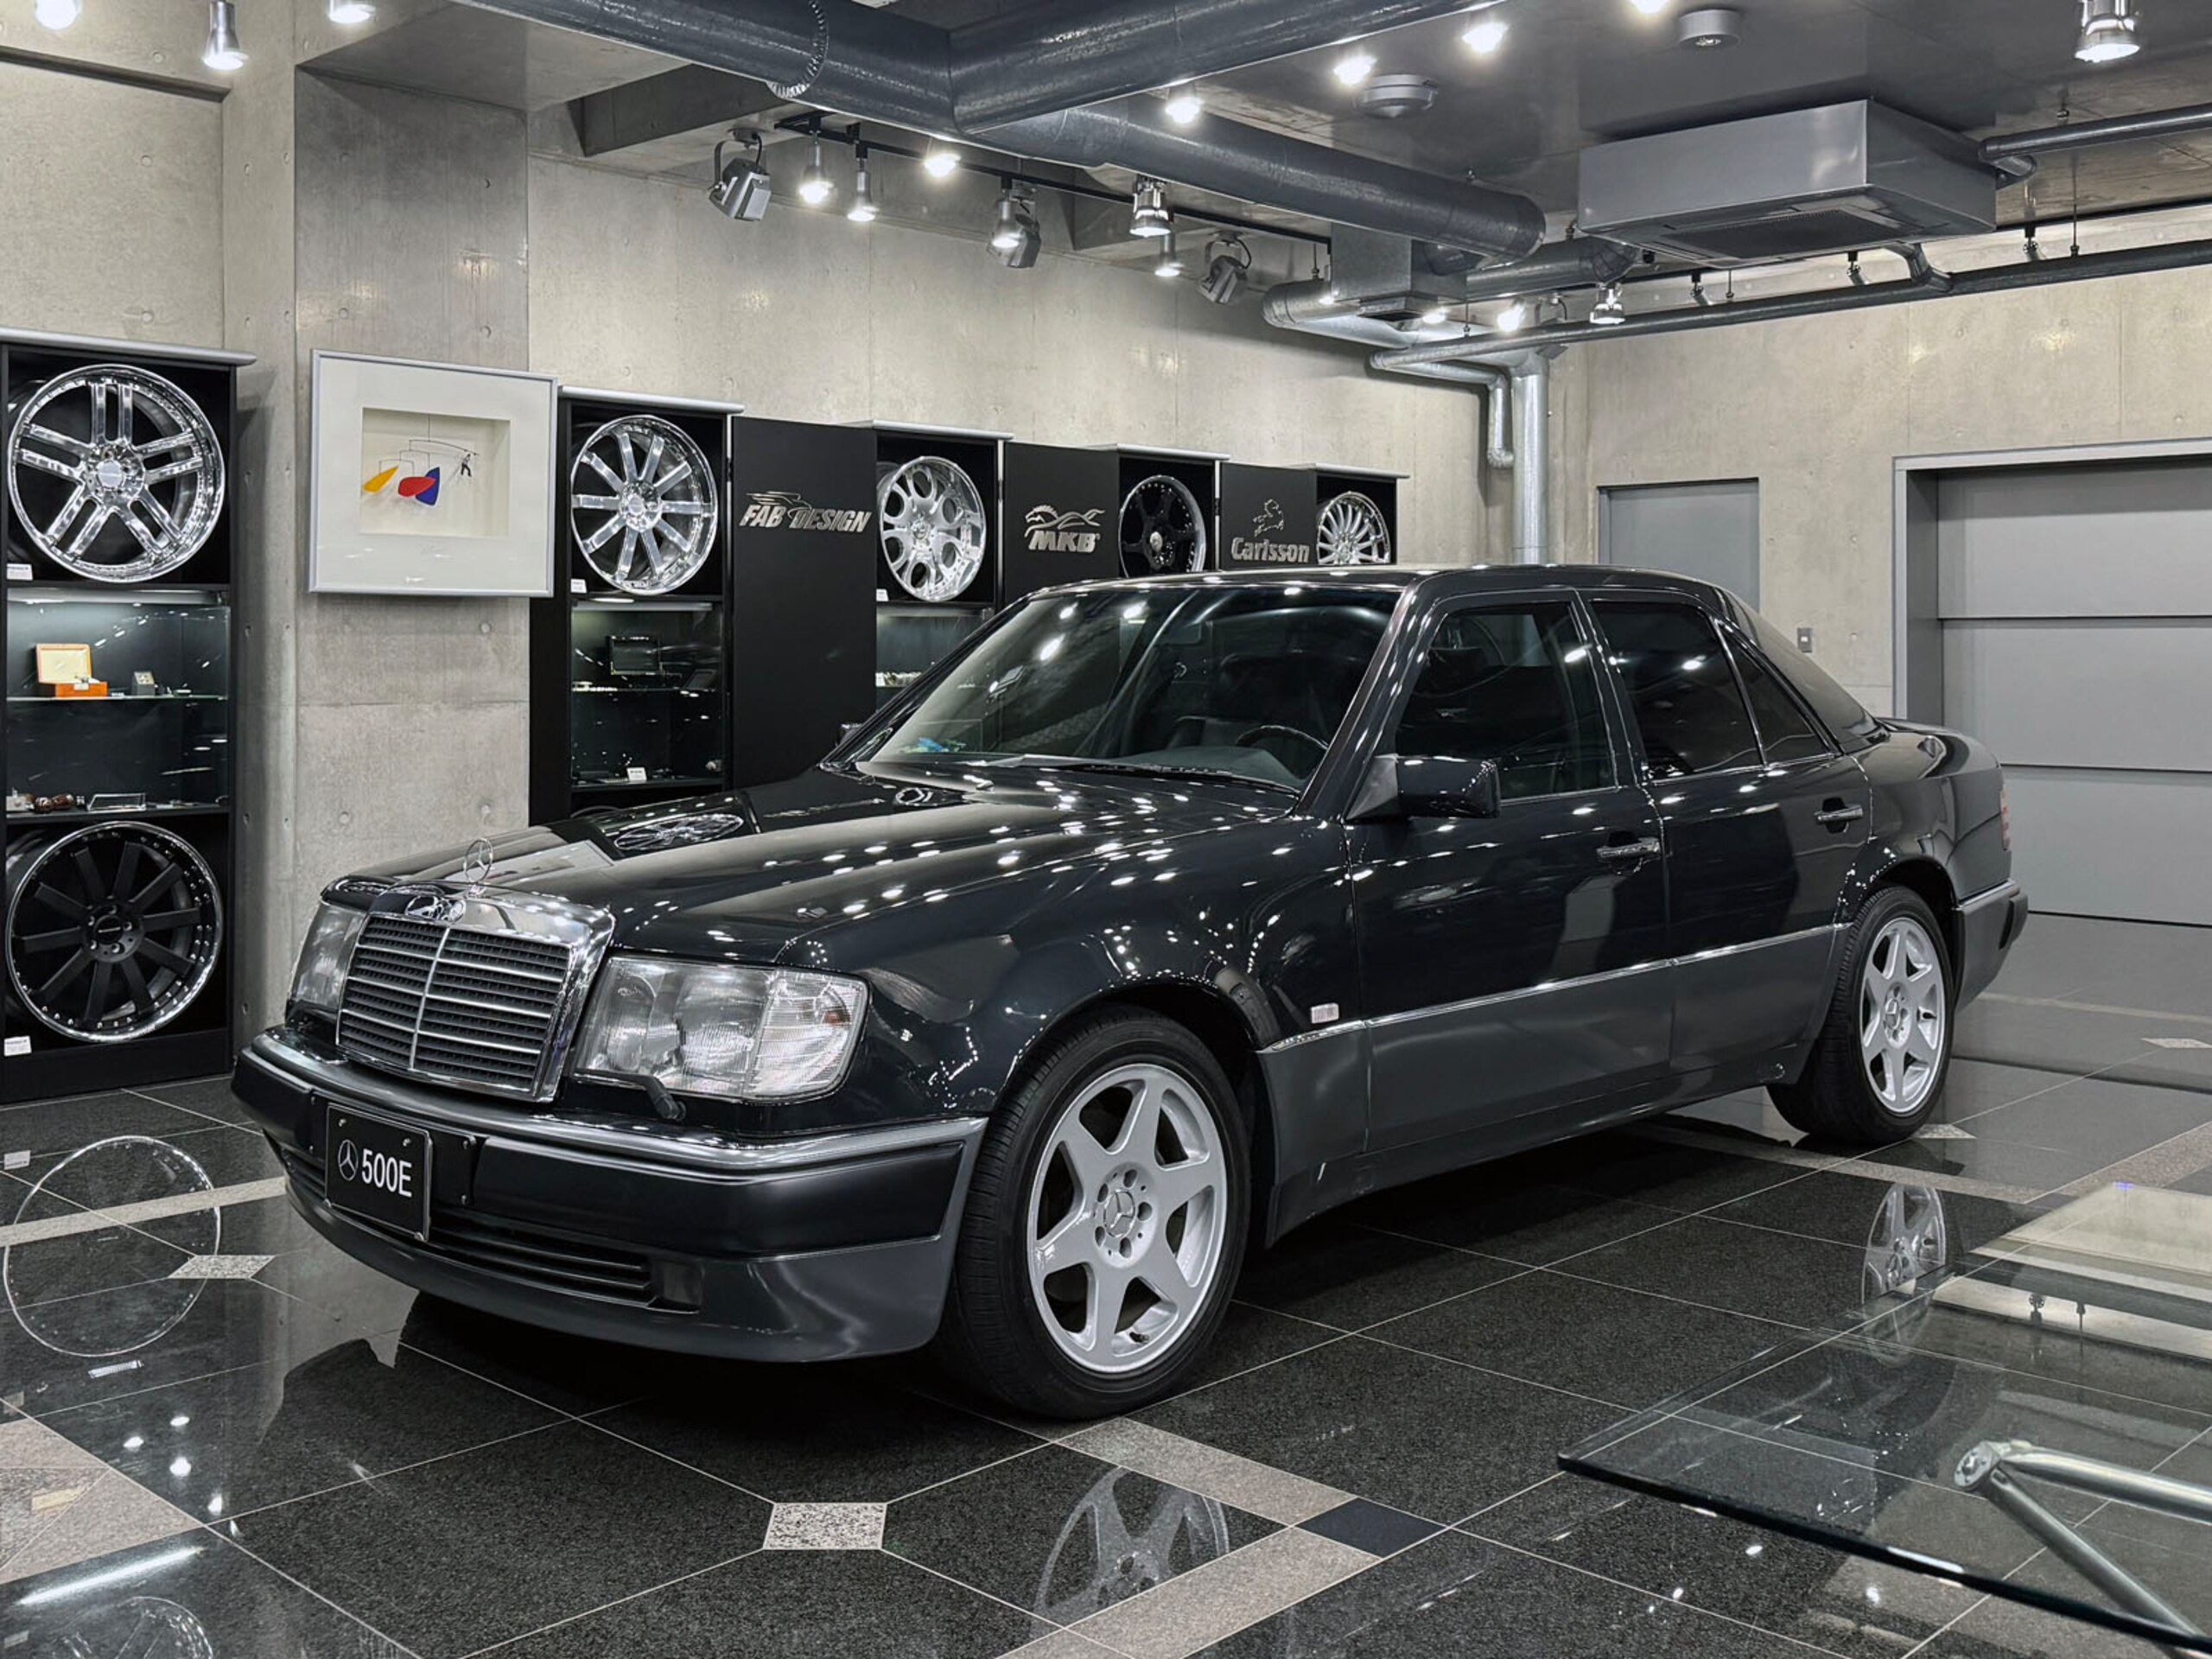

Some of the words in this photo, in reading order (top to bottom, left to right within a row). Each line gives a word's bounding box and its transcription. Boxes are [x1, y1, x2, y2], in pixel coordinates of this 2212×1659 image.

[739, 504, 787, 528] FAB
[789, 508, 872, 532] DESIGN
[1028, 531, 1096, 553] MKB
[1230, 537, 1310, 563] Carlsson
[361, 1147, 412, 1198] 500E
